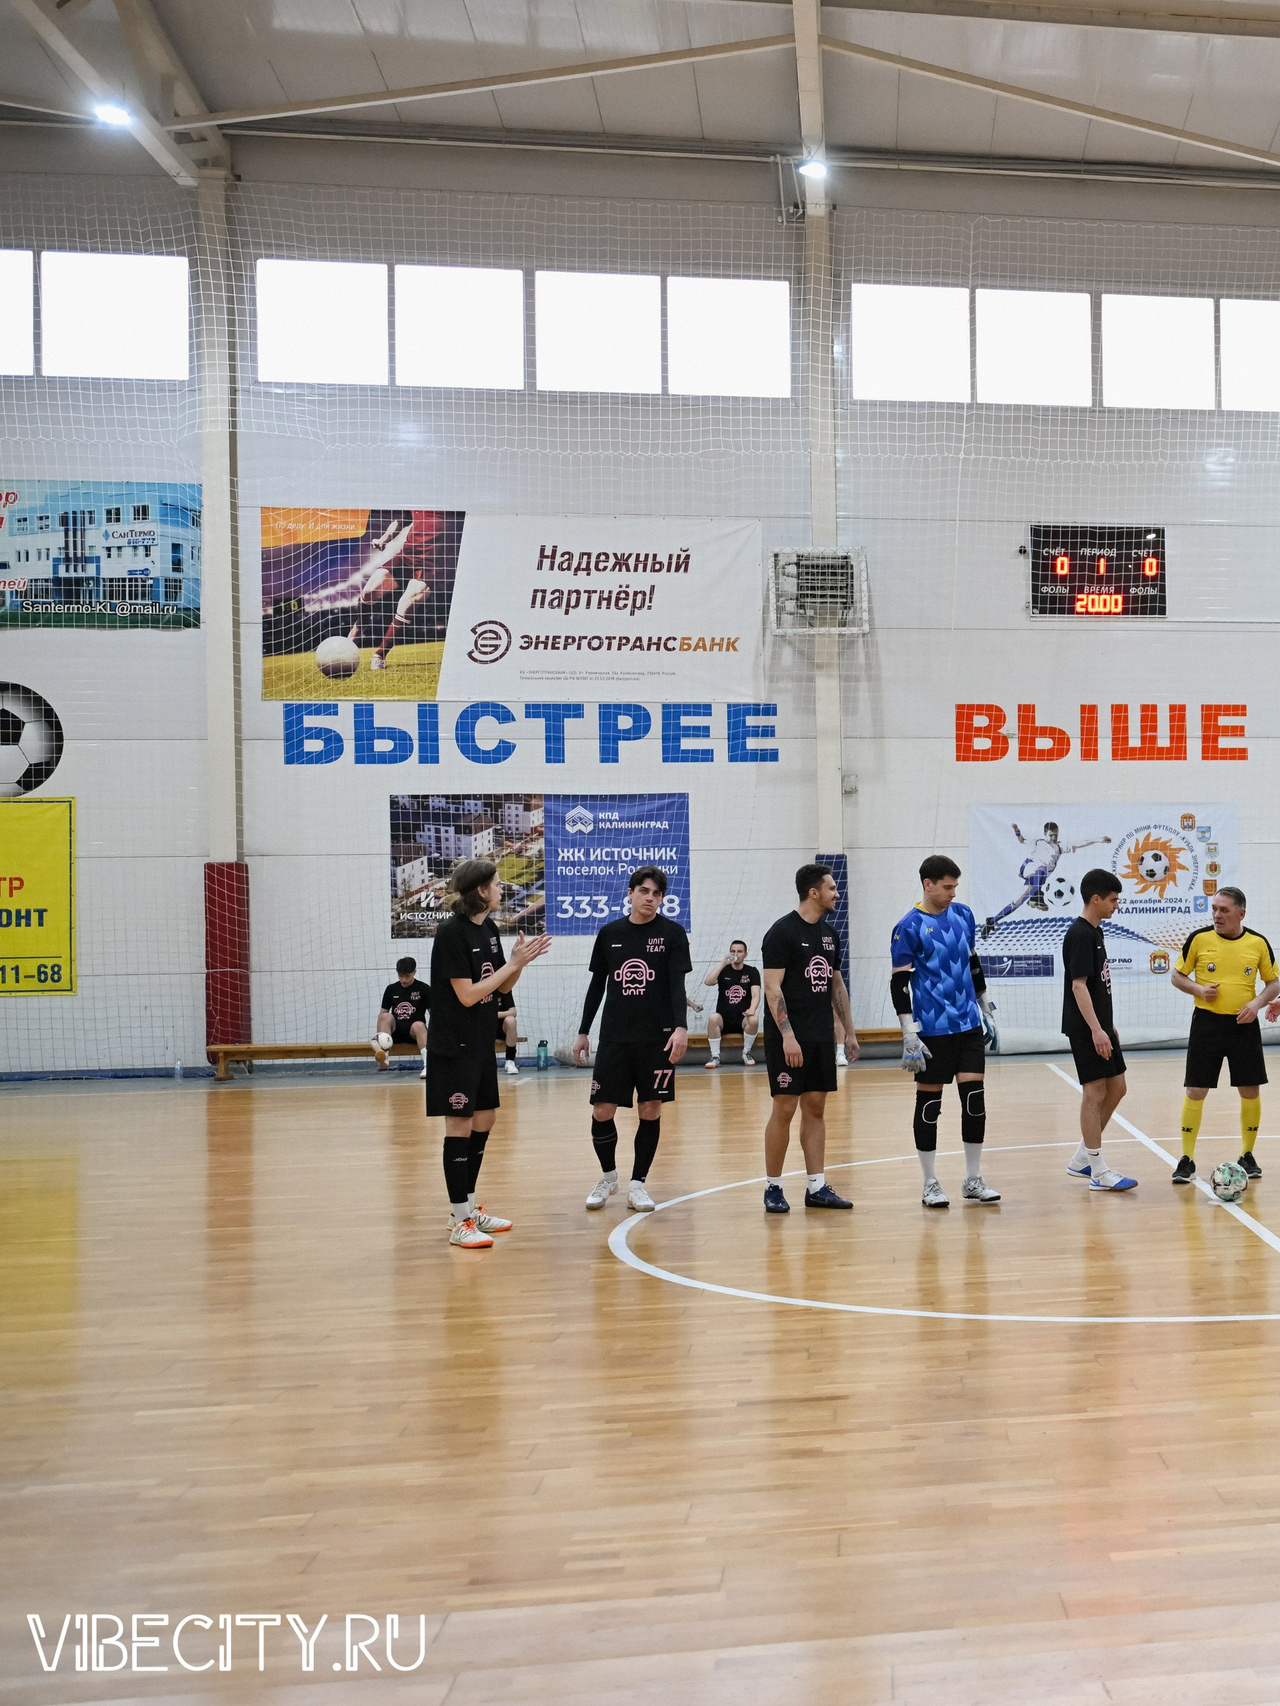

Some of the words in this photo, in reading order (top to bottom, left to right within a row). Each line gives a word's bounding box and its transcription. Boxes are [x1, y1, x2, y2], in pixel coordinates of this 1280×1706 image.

[1080, 548, 1117, 557] ПЕРИОД
[537, 545, 691, 576] Надежный
[1056, 556, 1069, 575] 0
[1099, 557, 1106, 575] 1
[1144, 557, 1157, 576] 0
[1041, 586, 1069, 594] ФОЛЫ
[1084, 586, 1115, 594] ВРЕМЯ
[1129, 587, 1158, 595] ФОЛЫ
[530, 584, 656, 617] партнёр!
[22, 601, 177, 616] Santermo-KL@mail.ru
[518, 634, 741, 652] ЭНЕРГОТРАНСБАНК
[283, 702, 779, 765] БЫСТРЕЕ
[955, 703, 1249, 762] ВЫШЕ
[599, 812, 619, 821] КПД
[599, 821, 669, 830] КАЛИНИНГРАД
[557, 848, 585, 861] ЖК
[589, 847, 677, 861] ИСТОЧНИК
[557, 865, 614, 876] поселок
[1117, 906, 1191, 914] КАЛИНИНГРАД
[646, 945, 666, 953] TEAM
[622, 988, 646, 996] UNIT
[653, 1069, 673, 1089] 77
